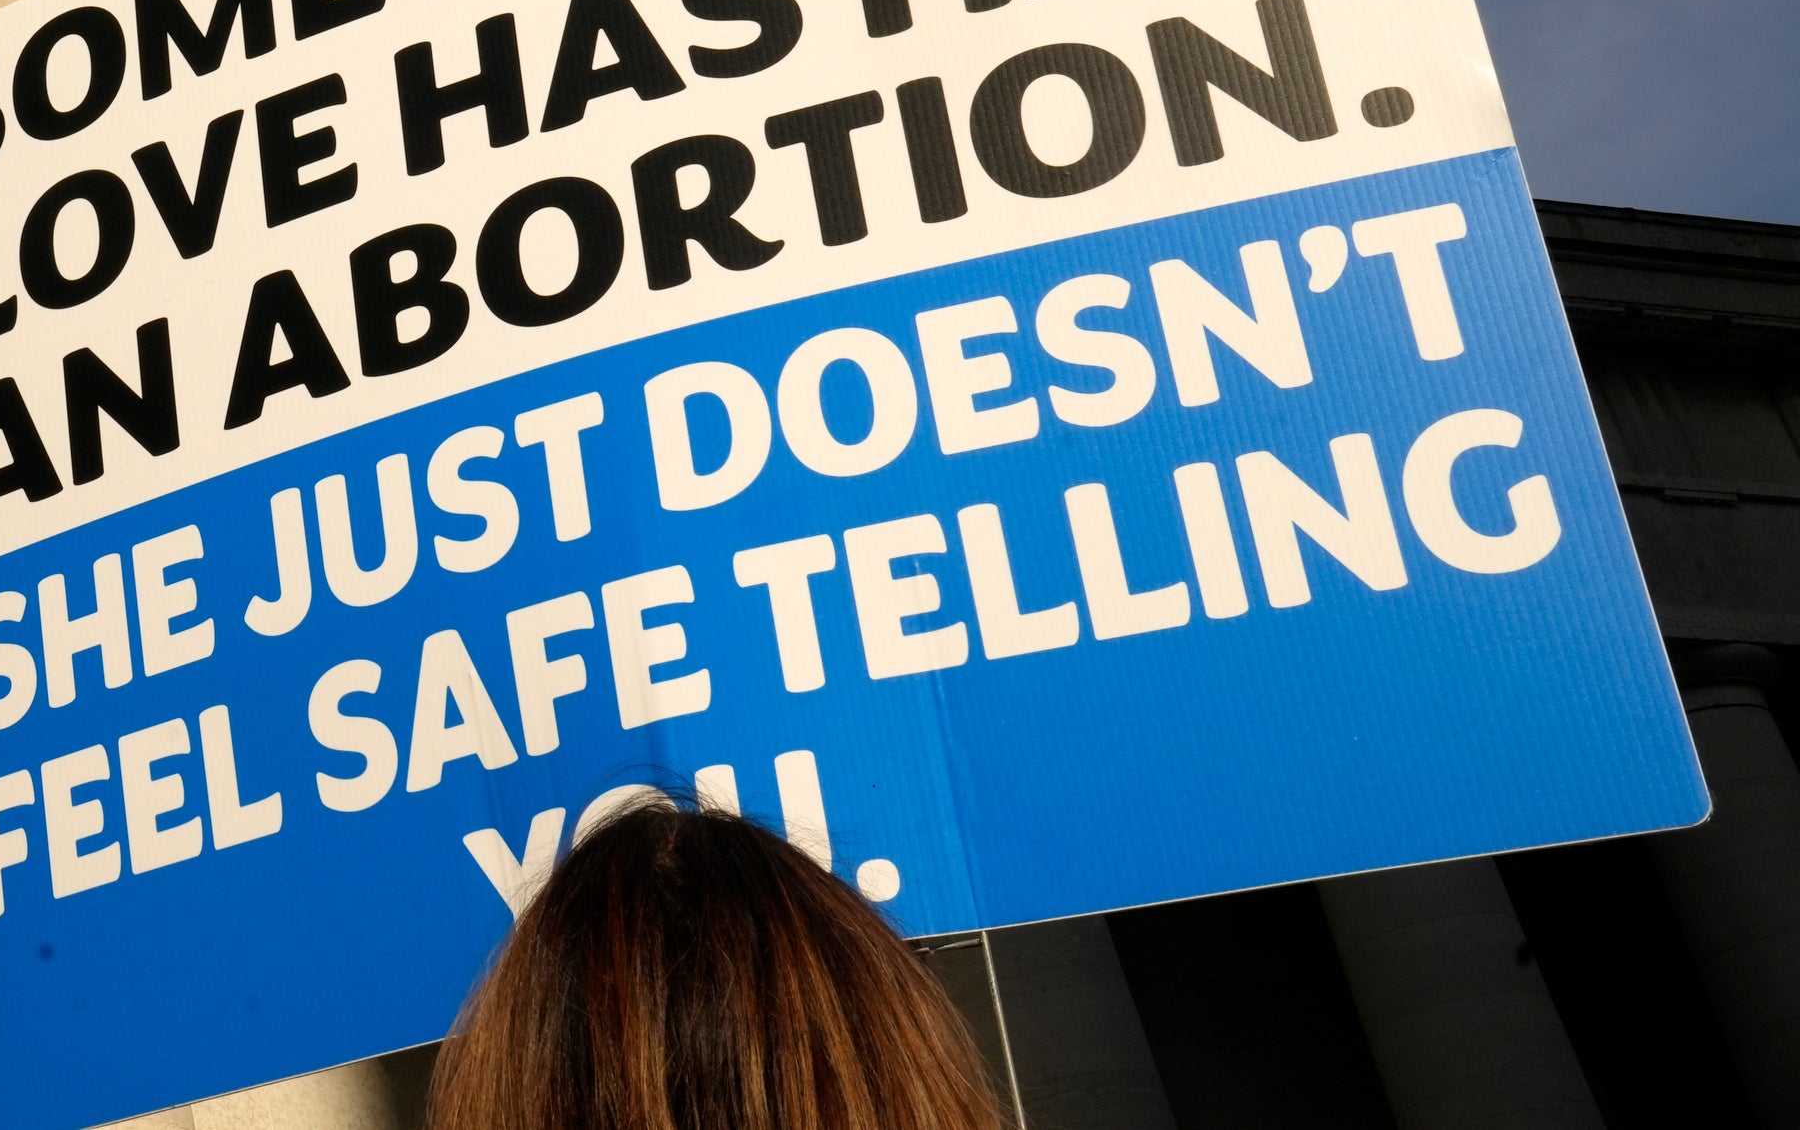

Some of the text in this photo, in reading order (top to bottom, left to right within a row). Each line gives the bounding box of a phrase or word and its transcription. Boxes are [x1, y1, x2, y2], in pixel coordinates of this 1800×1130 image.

[244, 391, 605, 637] JUST
[643, 202, 1468, 512] DOESN’T
[308, 564, 712, 813] SAFE
[732, 408, 1562, 693] TELLING
